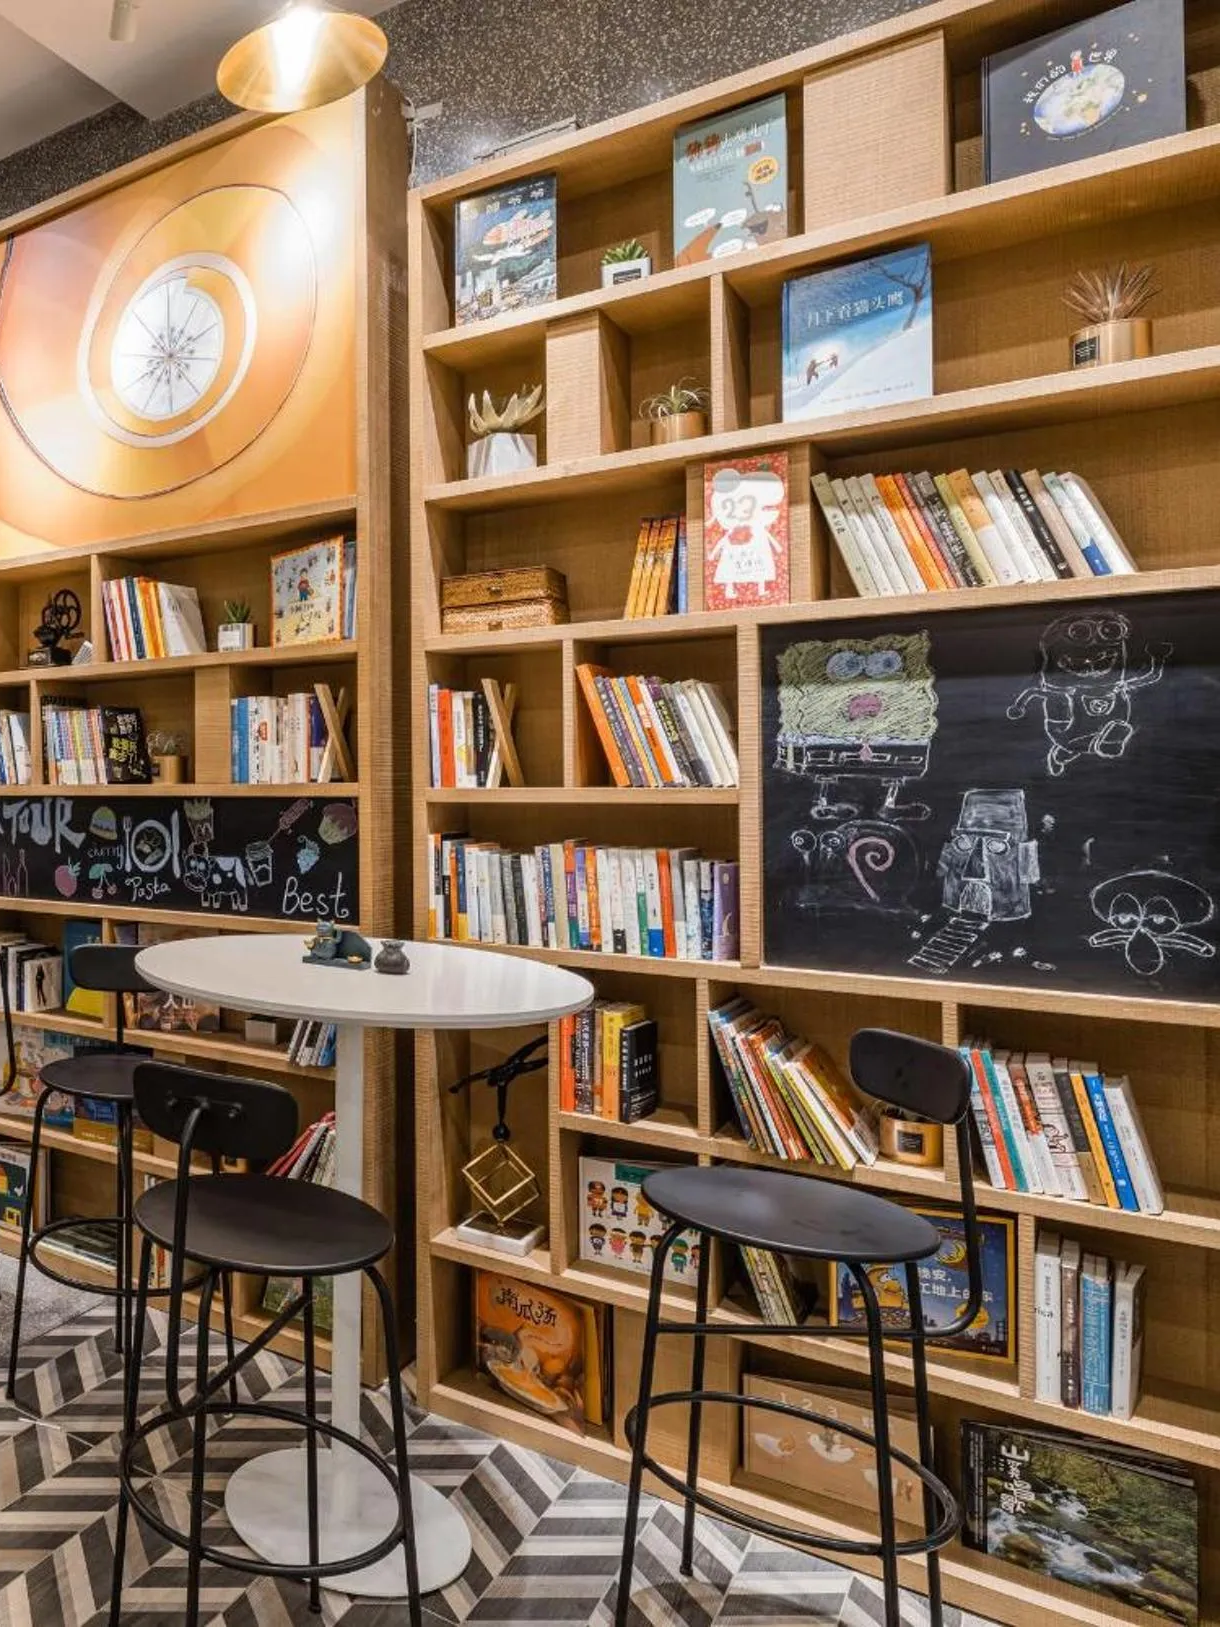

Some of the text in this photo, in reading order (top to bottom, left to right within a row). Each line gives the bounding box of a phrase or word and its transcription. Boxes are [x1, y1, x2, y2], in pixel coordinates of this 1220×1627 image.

[124, 876, 172, 902] Pasta
[282, 871, 349, 918] Best
[496, 1288, 557, 1327] 南瓜汤
